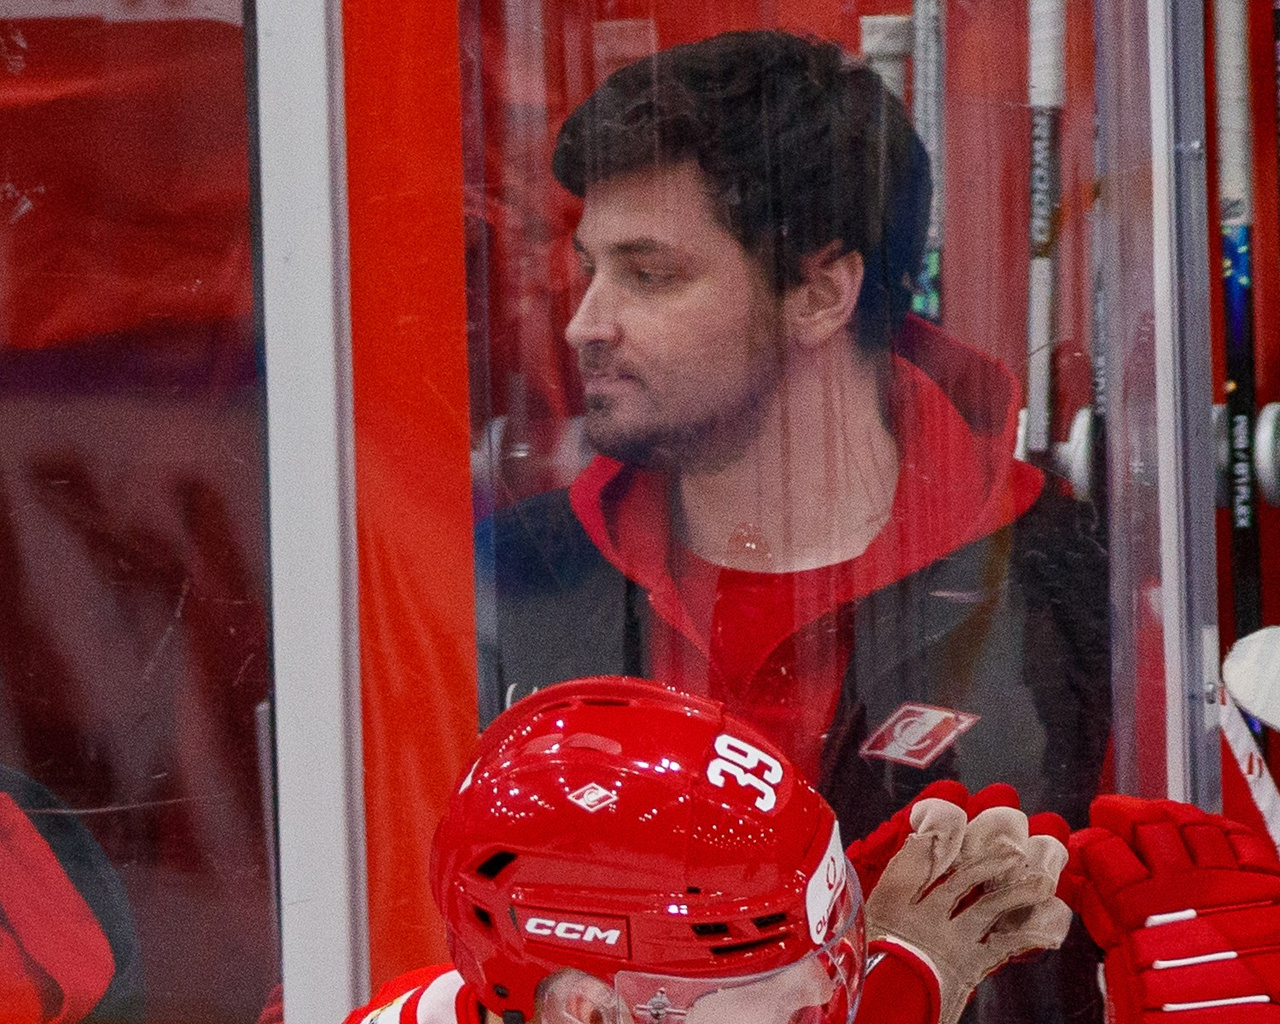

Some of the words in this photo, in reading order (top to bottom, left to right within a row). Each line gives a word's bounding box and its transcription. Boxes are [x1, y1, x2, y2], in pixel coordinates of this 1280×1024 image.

[1031, 111, 1052, 243] RWOOD
[706, 732, 784, 813] 39
[524, 916, 621, 946] CCM
